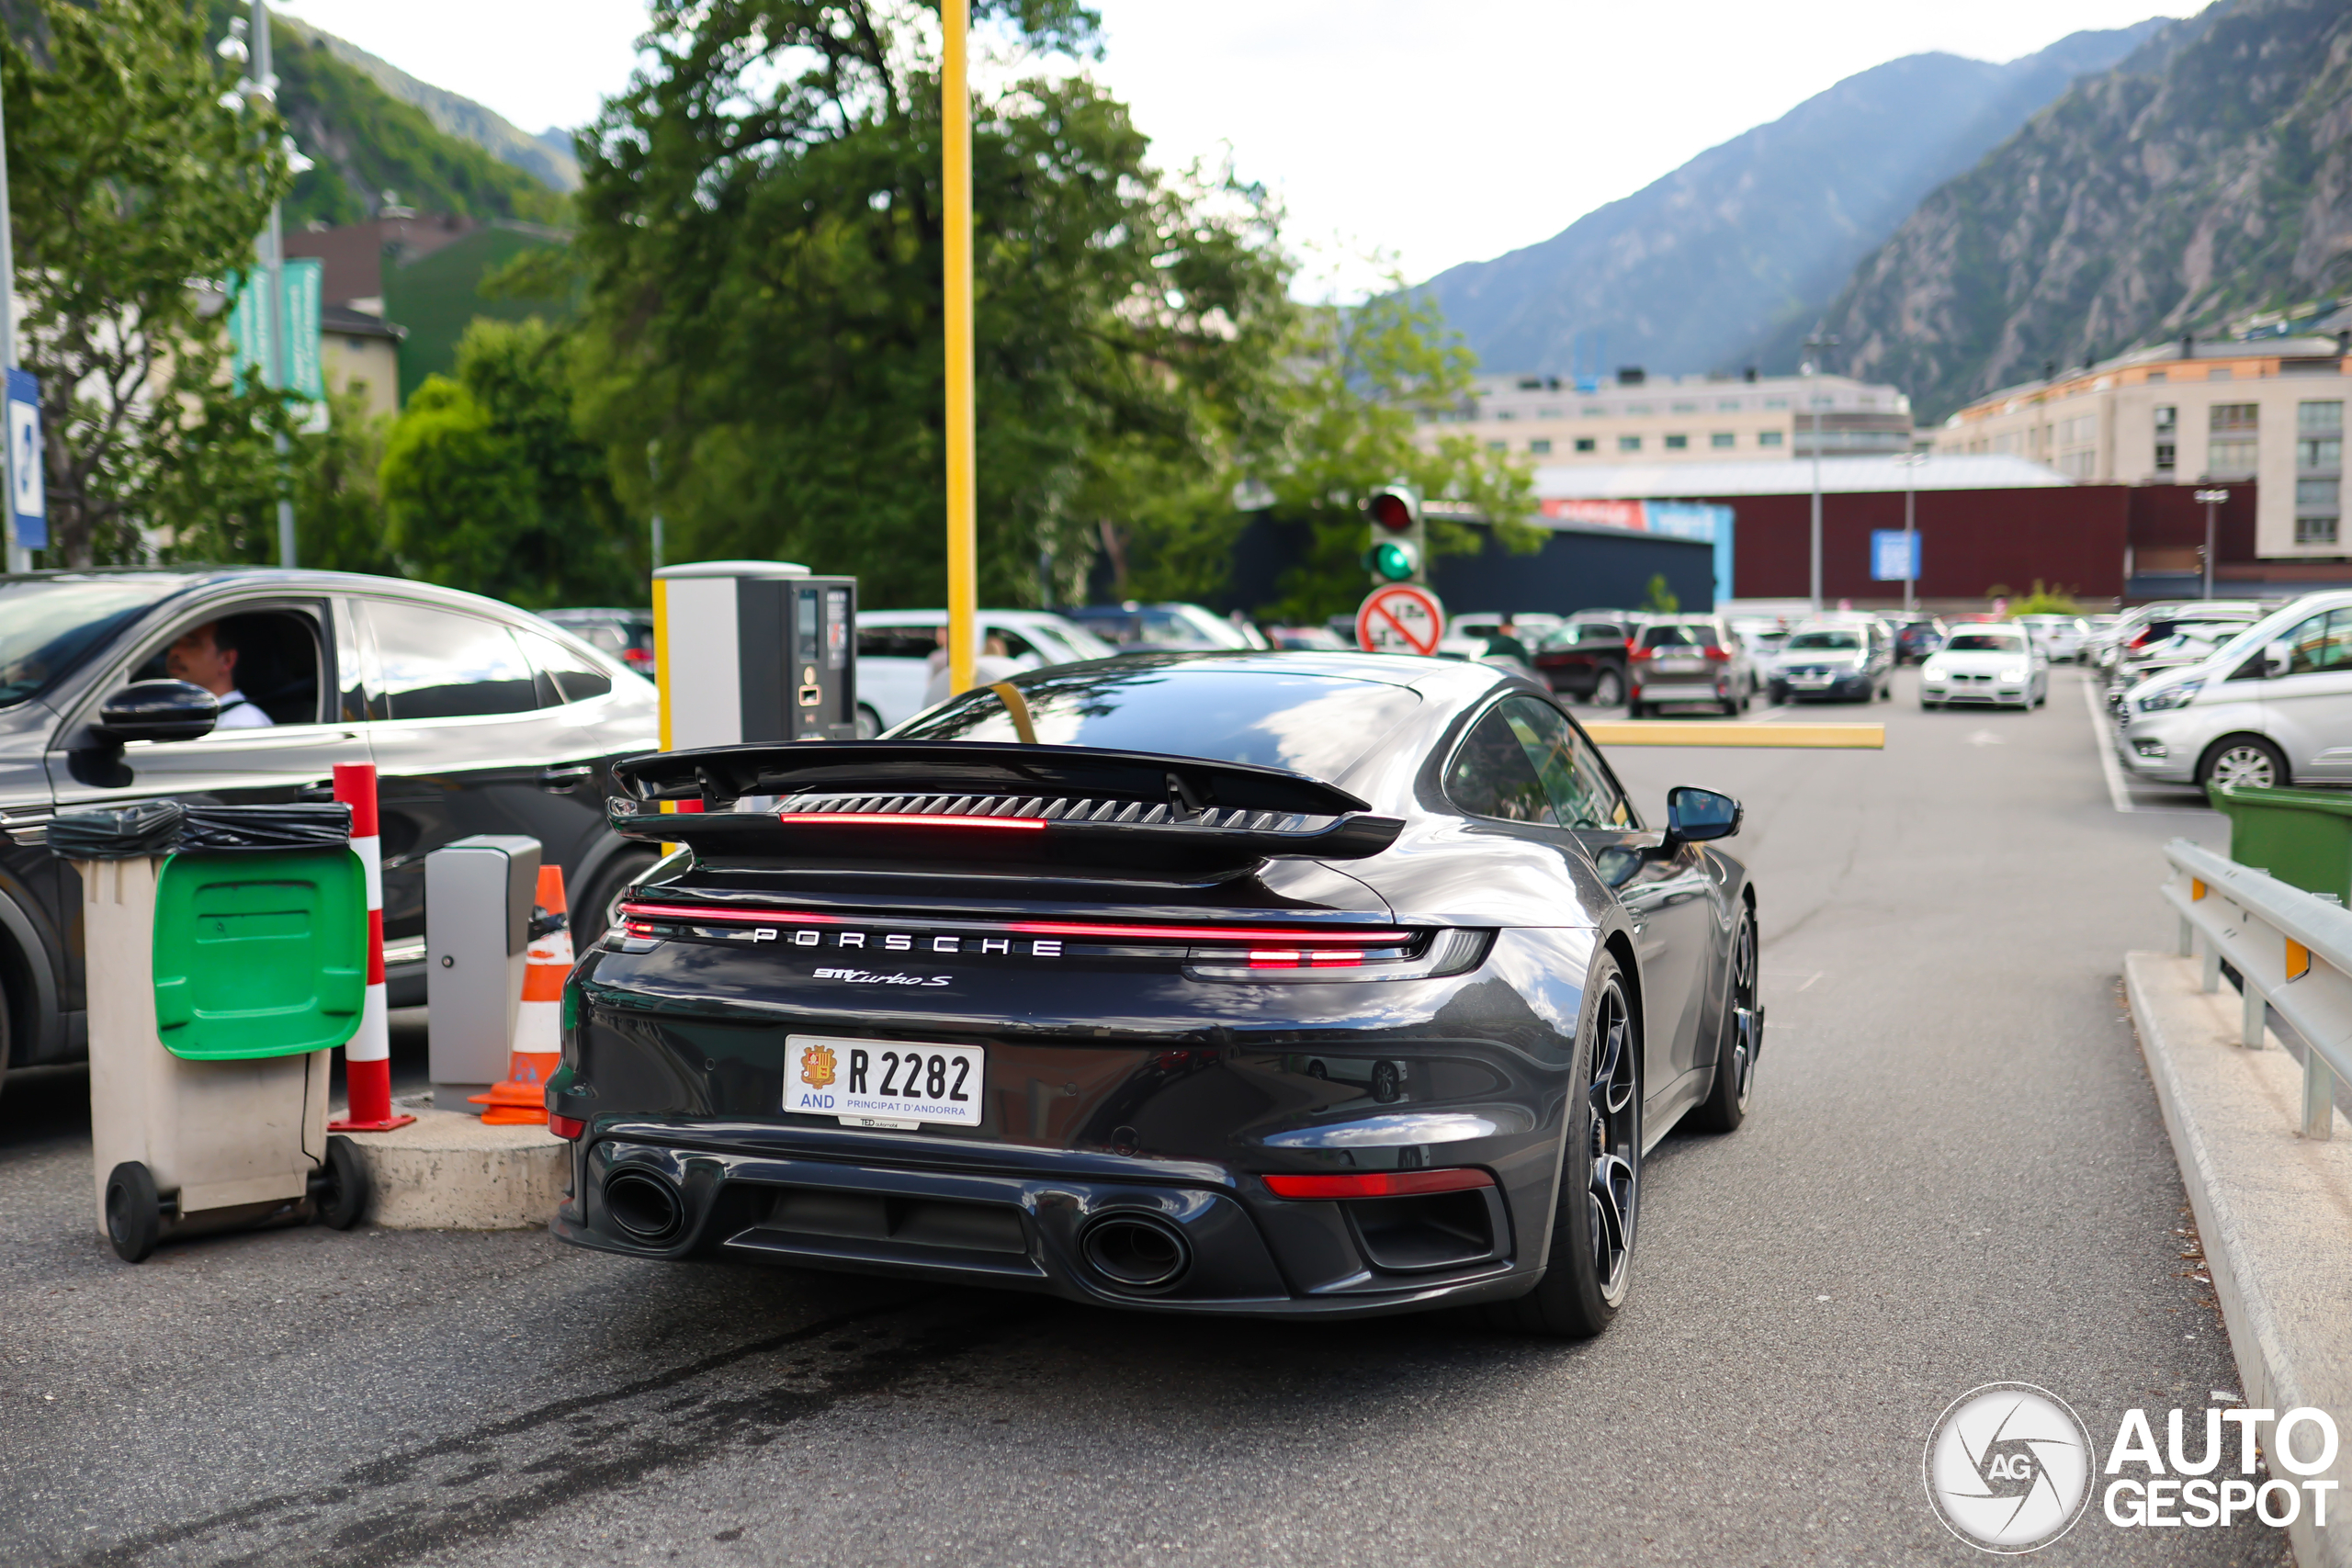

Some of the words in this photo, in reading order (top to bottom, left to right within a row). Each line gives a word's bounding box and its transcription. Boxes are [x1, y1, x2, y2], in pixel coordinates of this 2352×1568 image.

[752, 928, 1063, 957] PORSCHE
[921, 976, 954, 987] S
[1582, 990, 1600, 1081] GOODYEAR
[849, 1048, 869, 1094] R
[879, 1051, 970, 1101] 2282
[800, 1093, 835, 1109] AND
[846, 1100, 901, 1111] PRINCIPAT
[903, 1103, 967, 1116] D'ANDORRA
[860, 1118, 876, 1127] TED
